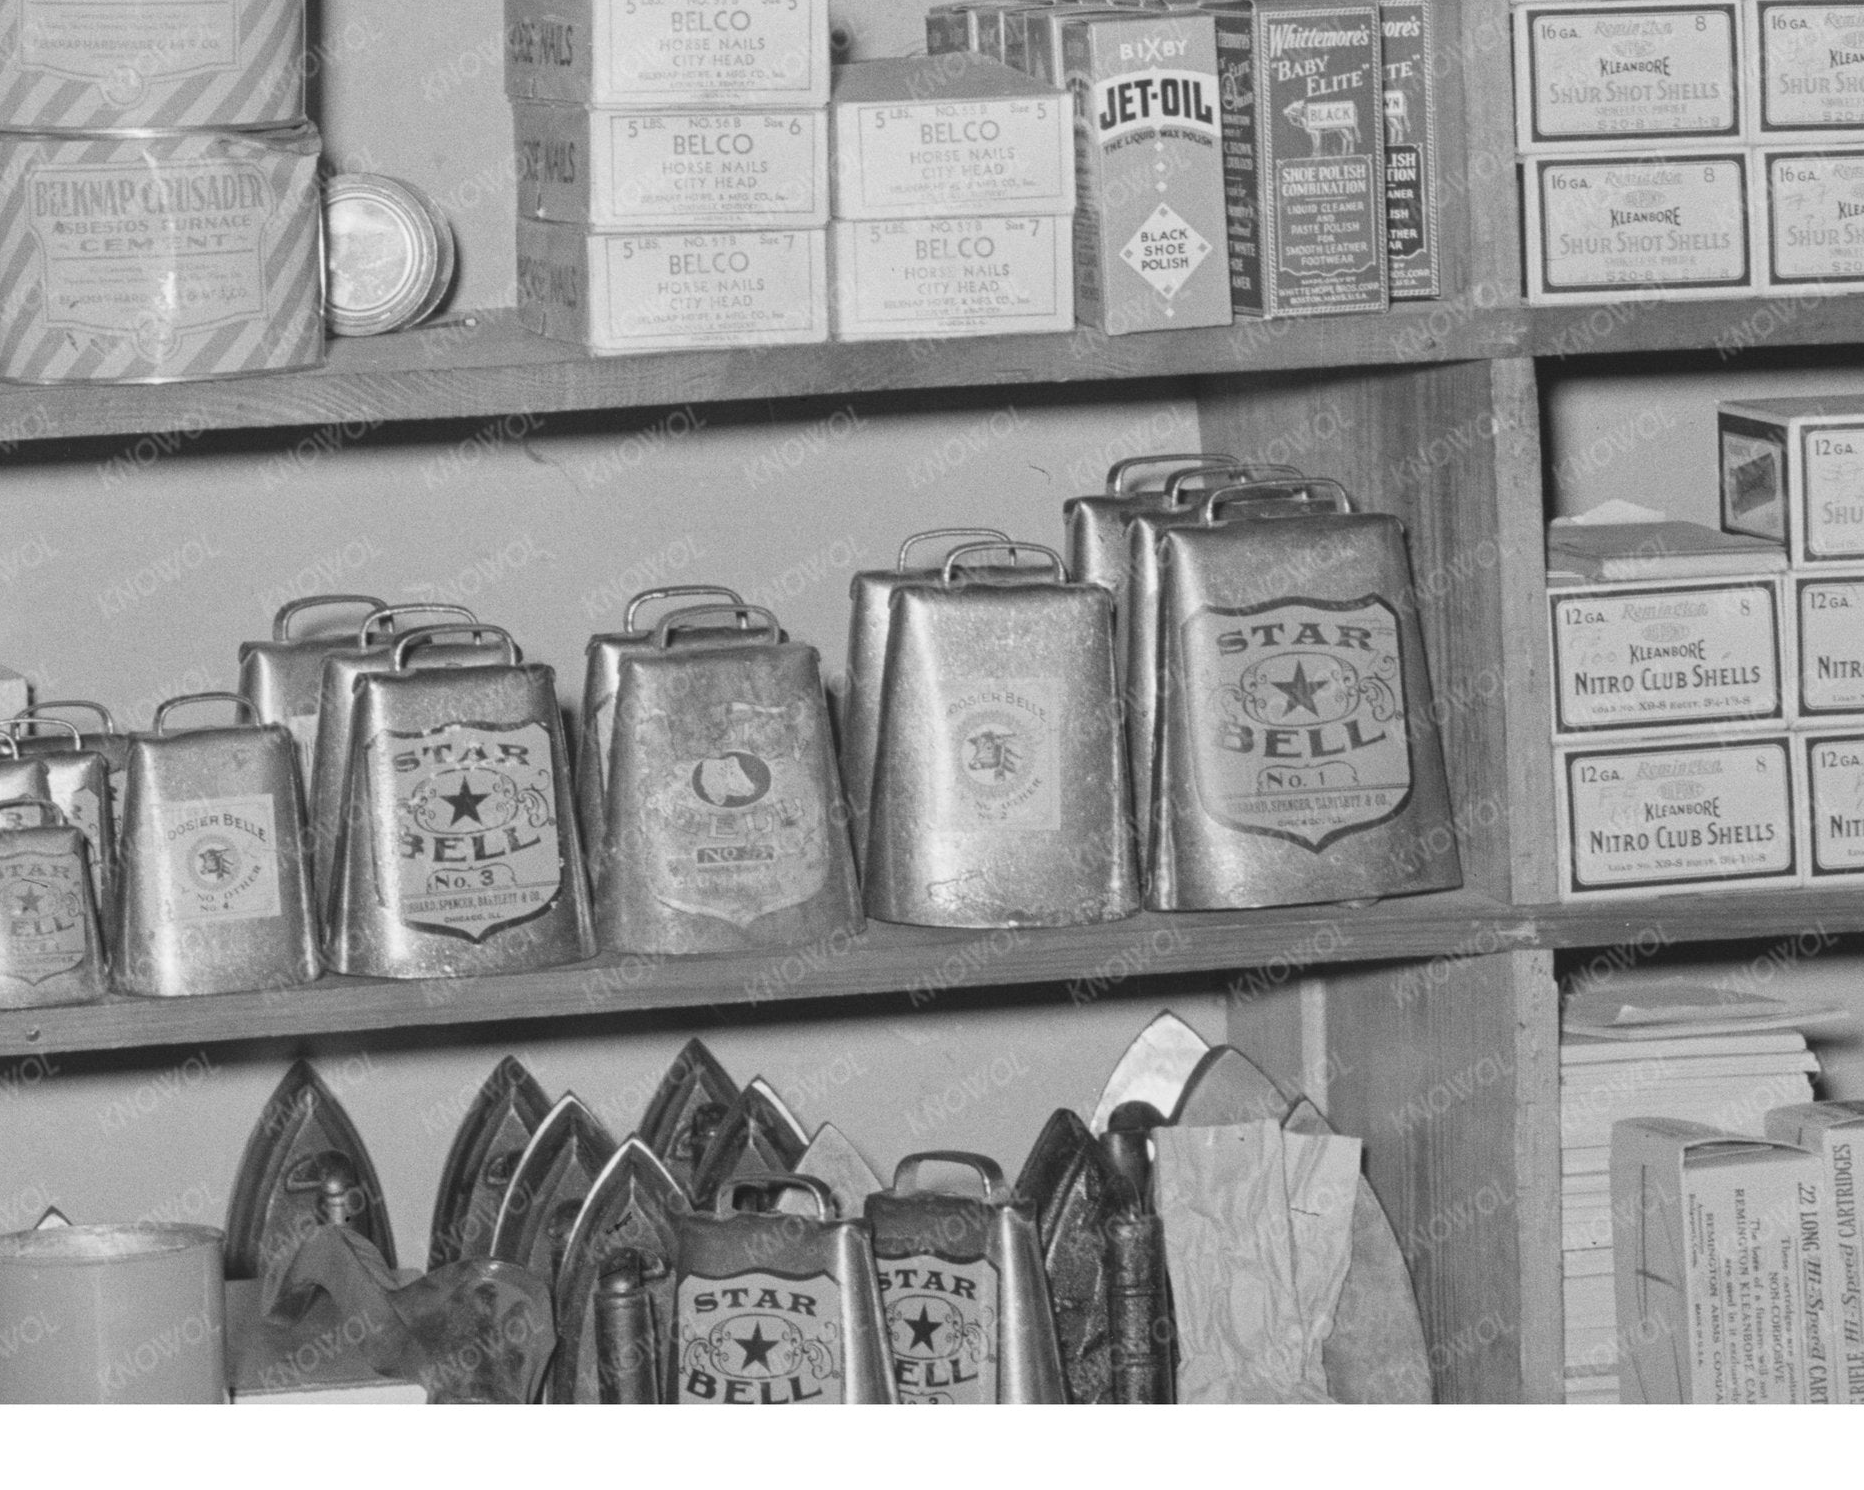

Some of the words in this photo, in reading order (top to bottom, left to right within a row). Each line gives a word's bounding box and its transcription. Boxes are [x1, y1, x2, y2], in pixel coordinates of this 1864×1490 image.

[671, 9, 751, 33] BELCO
[659, 38, 710, 51] HORSE
[719, 38, 766, 50] NAILS
[1119, 37, 1187, 62] BIXBY
[1269, 24, 1370, 57] Whittemore's
[672, 55, 705, 67] CITY
[712, 54, 755, 66] HEAD
[1099, 77, 1214, 131] JET-OIL
[673, 133, 753, 155] BELCO
[1282, 168, 1315, 184] SHOE
[1319, 165, 1366, 182] POLISH
[1282, 182, 1366, 197] COMBINATION
[1140, 229, 1188, 242] BLACK
[1144, 243, 1186, 256] SHOE
[1141, 257, 1189, 271] POLISH
[1215, 622, 1375, 655] STAR
[1573, 670, 1636, 695] NITRO
[1640, 668, 1689, 691] CLUB
[1692, 663, 1762, 688] SHELLS
[1218, 724, 1389, 759] BELL
[392, 743, 531, 773] STAR
[435, 873, 472, 889] No.
[693, 1288, 818, 1317] STAR
[685, 1369, 825, 1404] BELL
